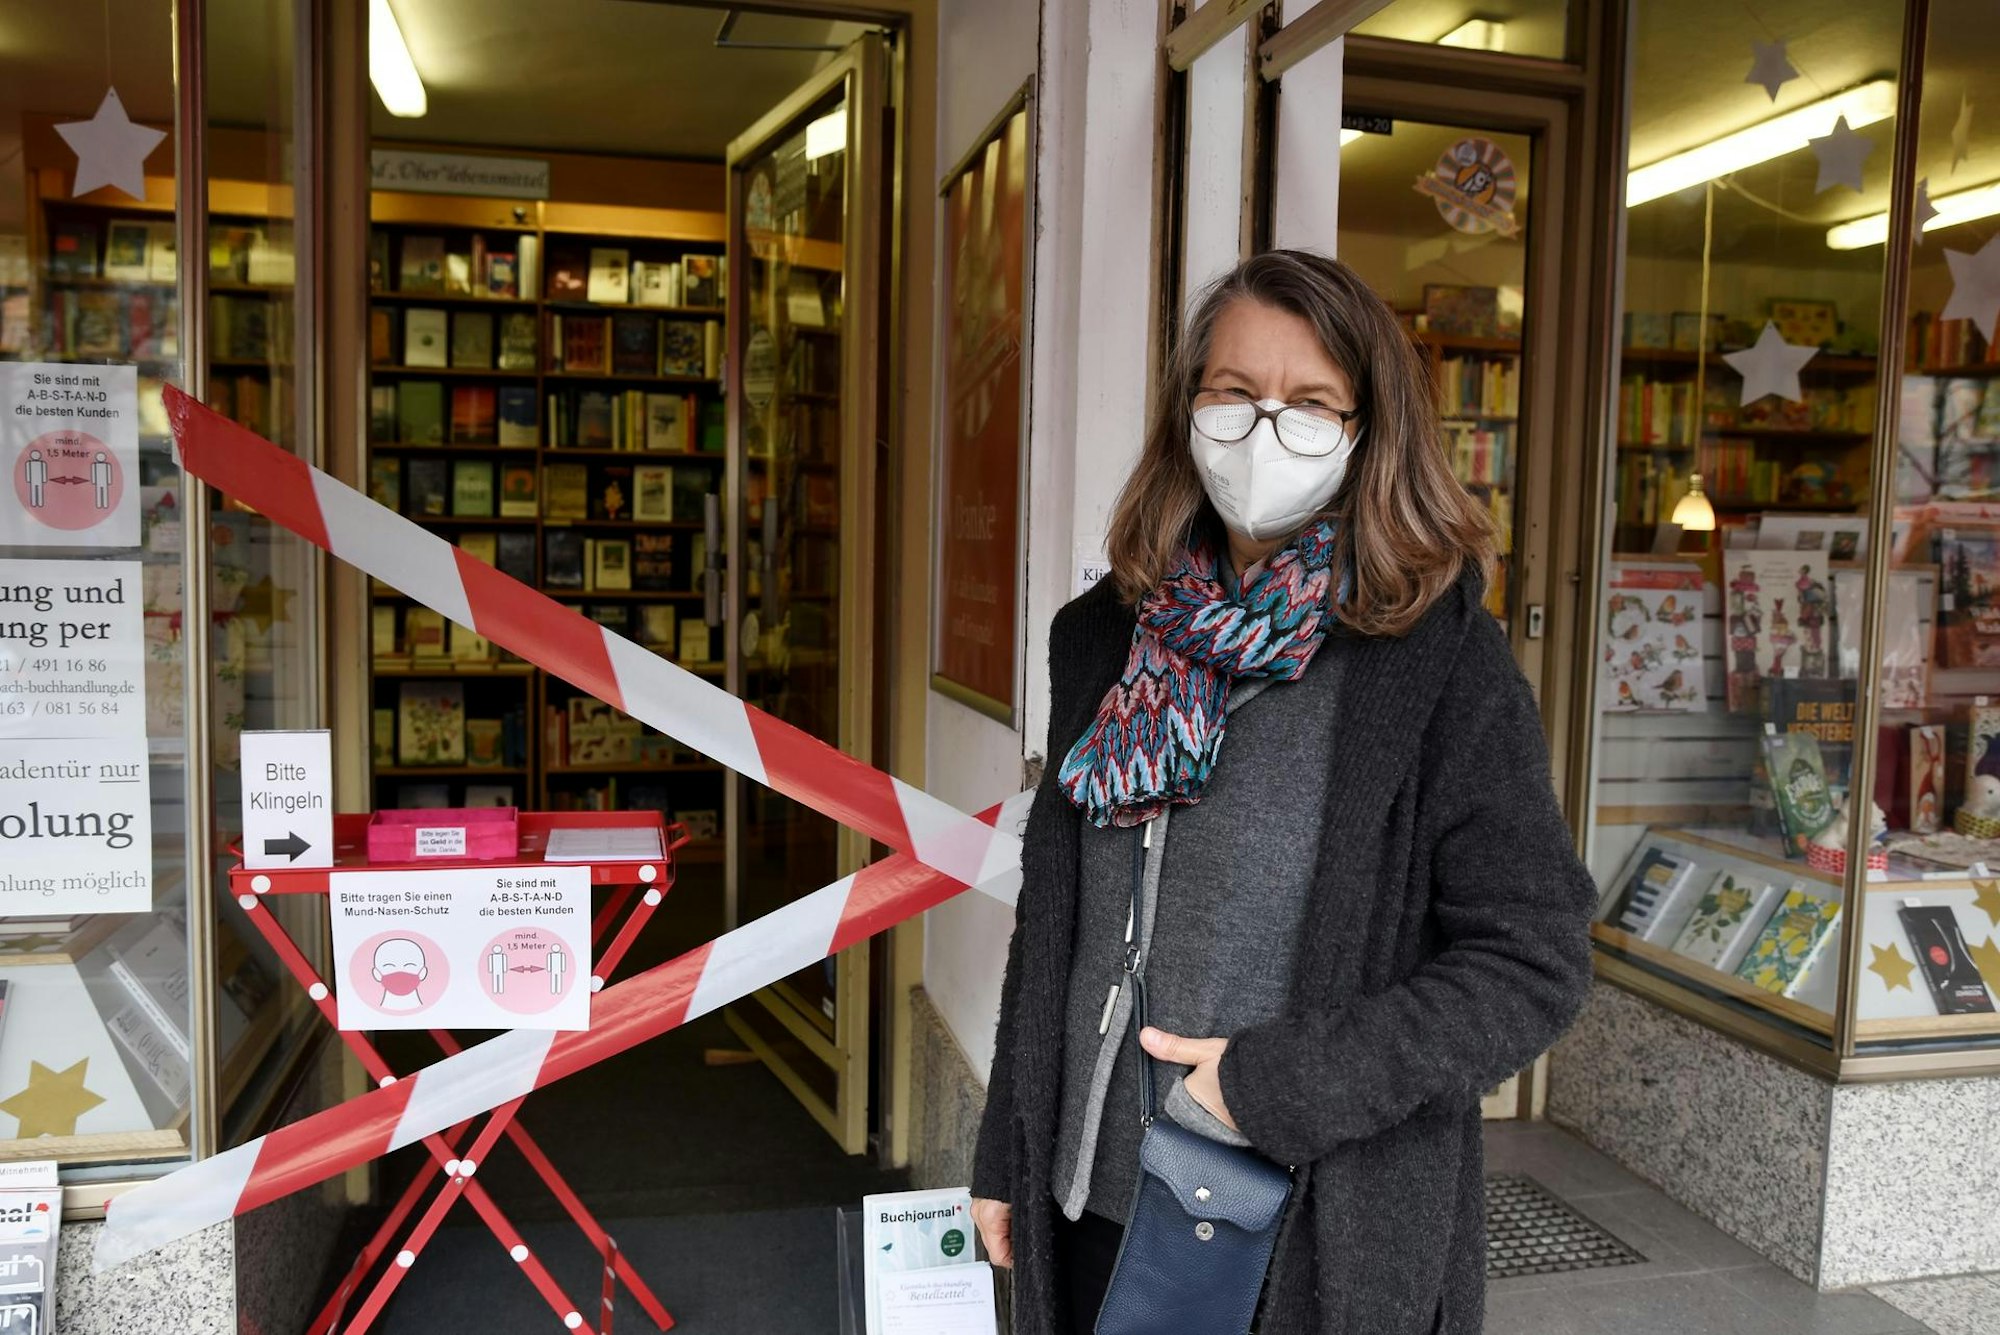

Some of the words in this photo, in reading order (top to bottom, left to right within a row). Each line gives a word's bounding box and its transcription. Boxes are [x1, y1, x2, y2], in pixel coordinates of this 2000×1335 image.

[34, 373, 51, 385] Sie
[55, 374, 78, 386] sind
[82, 376, 100, 387] mit
[27, 389, 107, 402] A-B-S-T-A-N-D
[15, 405, 33, 416] die
[36, 406, 73, 417] besten
[77, 406, 120, 419] Kunden
[55, 437, 82, 446] mind.
[46, 448, 60, 459] 1,5
[62, 449, 90, 458] Meter
[1083, 568, 1106, 580] Kli
[63, 577, 125, 604] und
[59, 621, 111, 648] per
[32, 658, 58, 671] 491
[67, 659, 83, 671] 16
[88, 659, 107, 671] 86
[0, 680, 135, 697] ach-buchhandlung.de
[45, 701, 71, 714] 081
[79, 702, 96, 714] 56
[101, 702, 120, 714] 84
[1796, 702, 1818, 720] DIE
[99, 763, 140, 783] nur
[266, 763, 306, 781] Bitte
[250, 791, 323, 814] Klingeln
[62, 870, 146, 895] möglich
[496, 879, 513, 889] Sie
[515, 879, 537, 888] sind
[540, 879, 556, 888] mit
[340, 893, 365, 902] Bitte
[368, 893, 401, 904] tragen
[404, 892, 421, 902] Sie
[423, 892, 452, 901] einen
[490, 892, 563, 903] A-B-S-T-A-N-D
[344, 906, 449, 916] Mund-Nasen-Schutz
[479, 907, 495, 917] die
[497, 906, 532, 916] besten
[534, 905, 574, 915] Kunden
[507, 943, 519, 951] 1,5
[521, 942, 547, 950] Meter
[880, 1205, 955, 1223] Buchjournal
